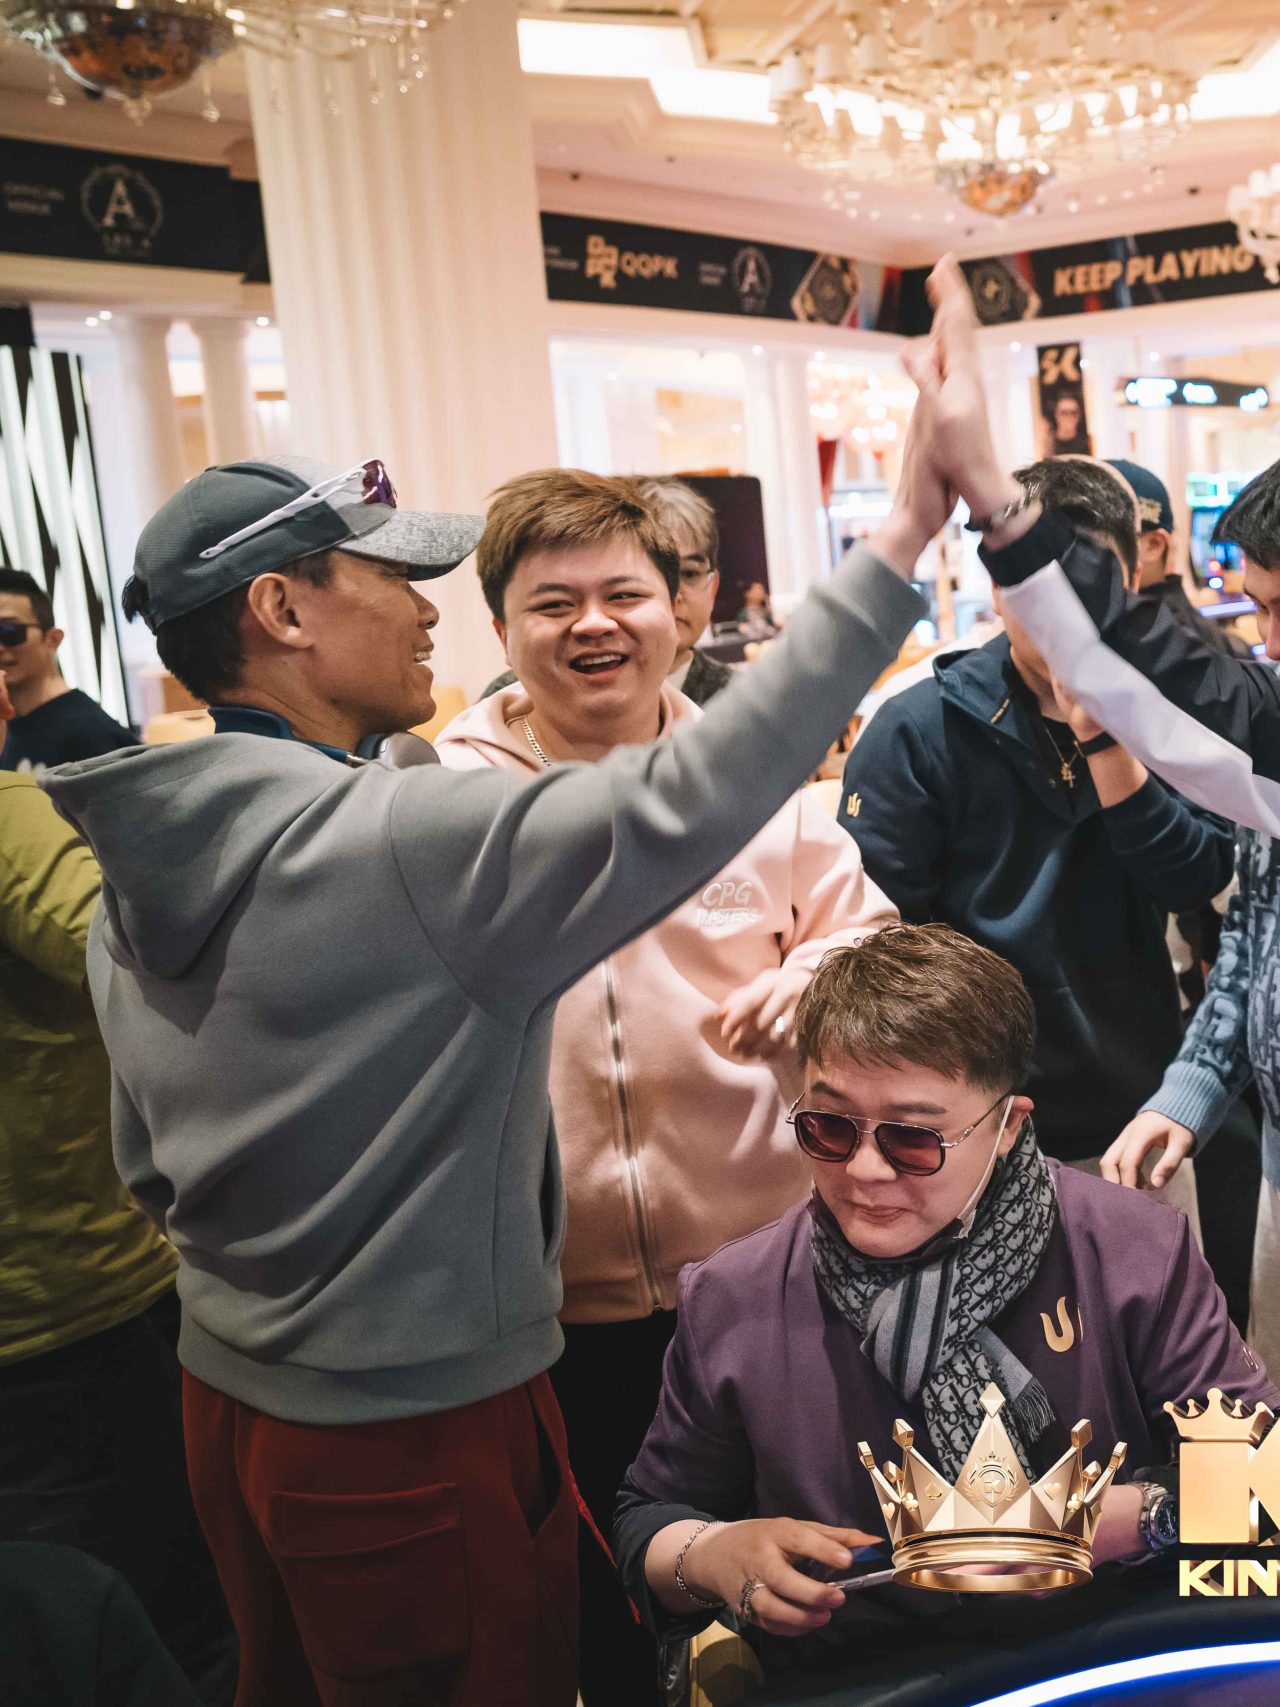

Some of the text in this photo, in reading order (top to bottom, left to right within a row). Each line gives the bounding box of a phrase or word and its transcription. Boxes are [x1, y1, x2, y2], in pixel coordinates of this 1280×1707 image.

[1054, 245, 1256, 297] KEEP PLAYING
[702, 881, 753, 908] CPG
